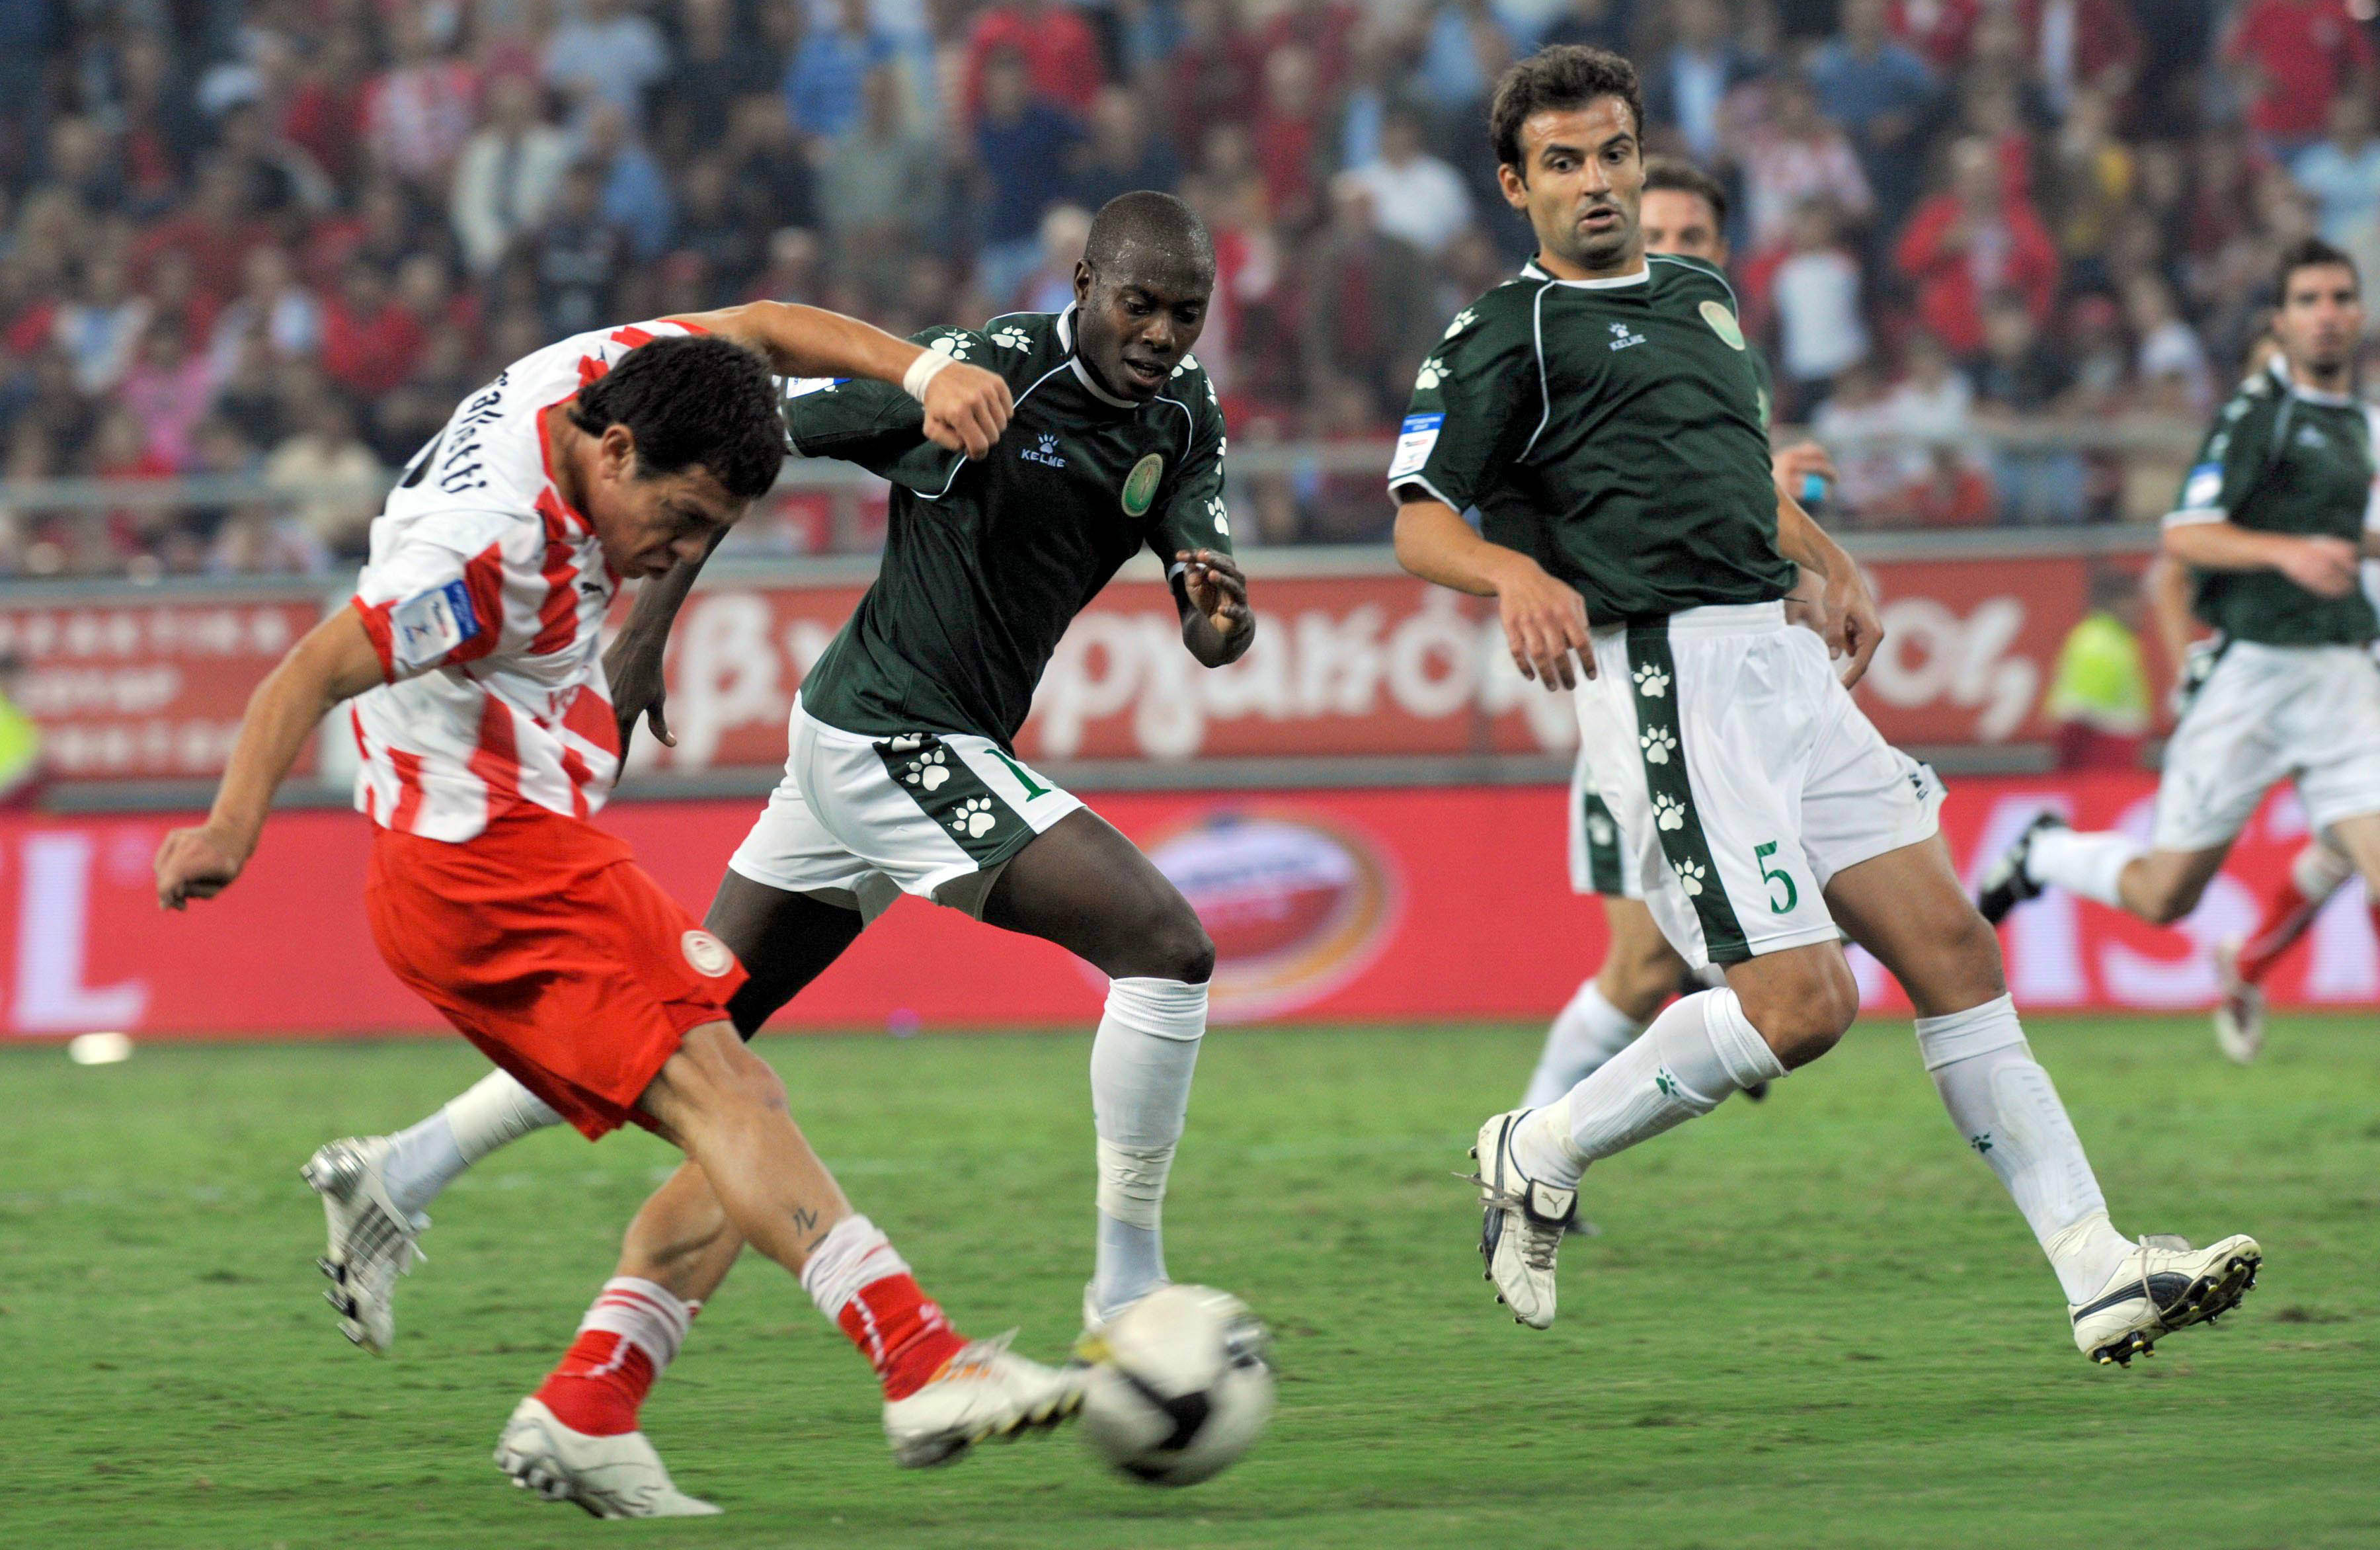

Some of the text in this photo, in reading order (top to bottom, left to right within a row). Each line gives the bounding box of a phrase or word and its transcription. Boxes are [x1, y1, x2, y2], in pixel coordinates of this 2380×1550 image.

[1021, 448, 1066, 468] KELME
[983, 748, 1059, 803] 1
[1753, 840, 1798, 914] 5
